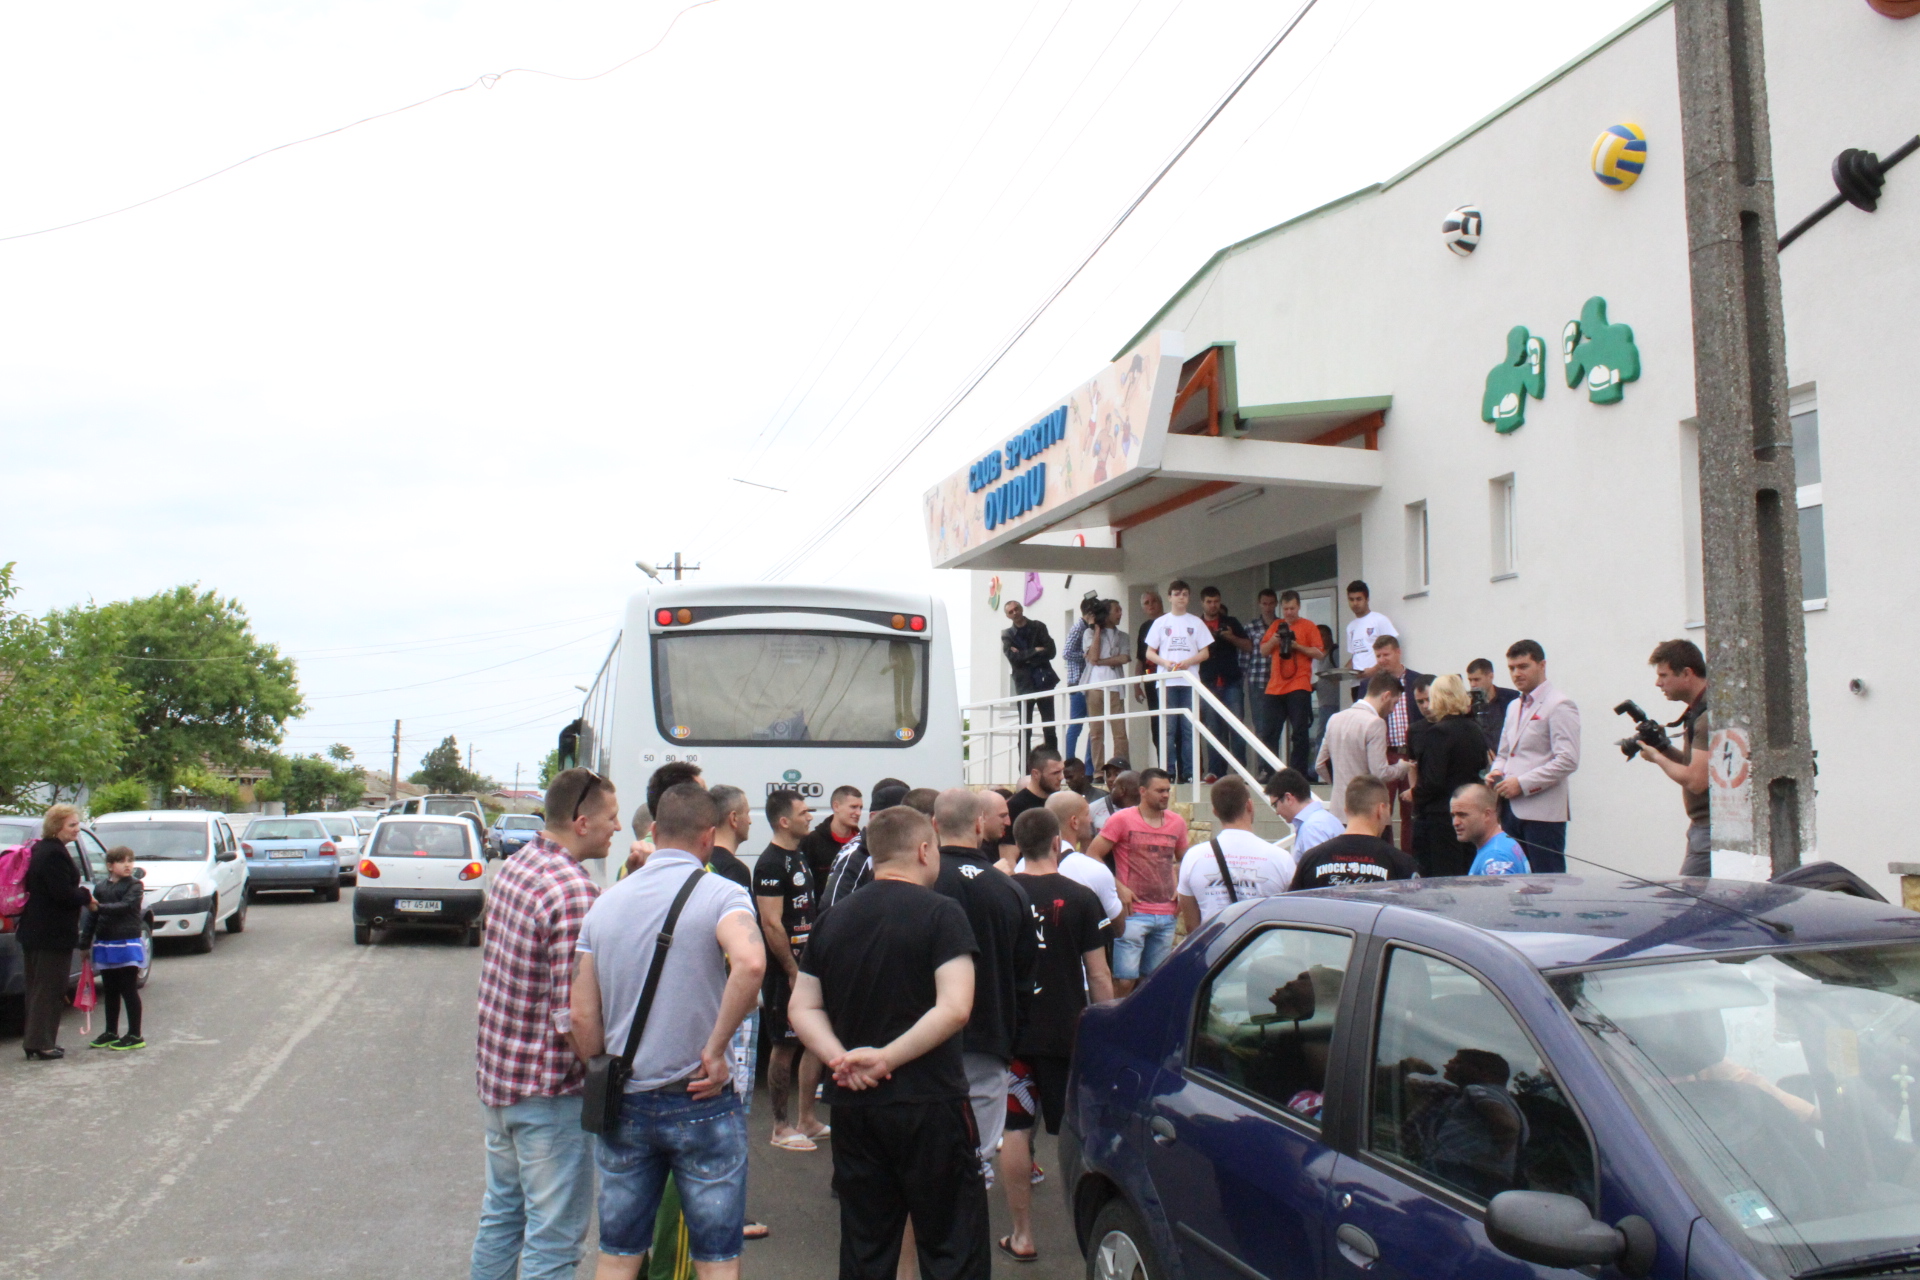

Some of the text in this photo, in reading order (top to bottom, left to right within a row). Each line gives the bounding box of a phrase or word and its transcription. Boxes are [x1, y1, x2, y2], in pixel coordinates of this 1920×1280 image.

[969, 405, 1068, 493] CLUB SPORTIV
[984, 462, 1046, 530] OVIDIU
[644, 754, 654, 762] 50
[665, 754, 676, 762] 80
[686, 754, 698, 762] 100
[1316, 862, 1388, 881] KNOCK DOWN
[414, 901, 423, 909] 45
[425, 901, 439, 909] AMA
